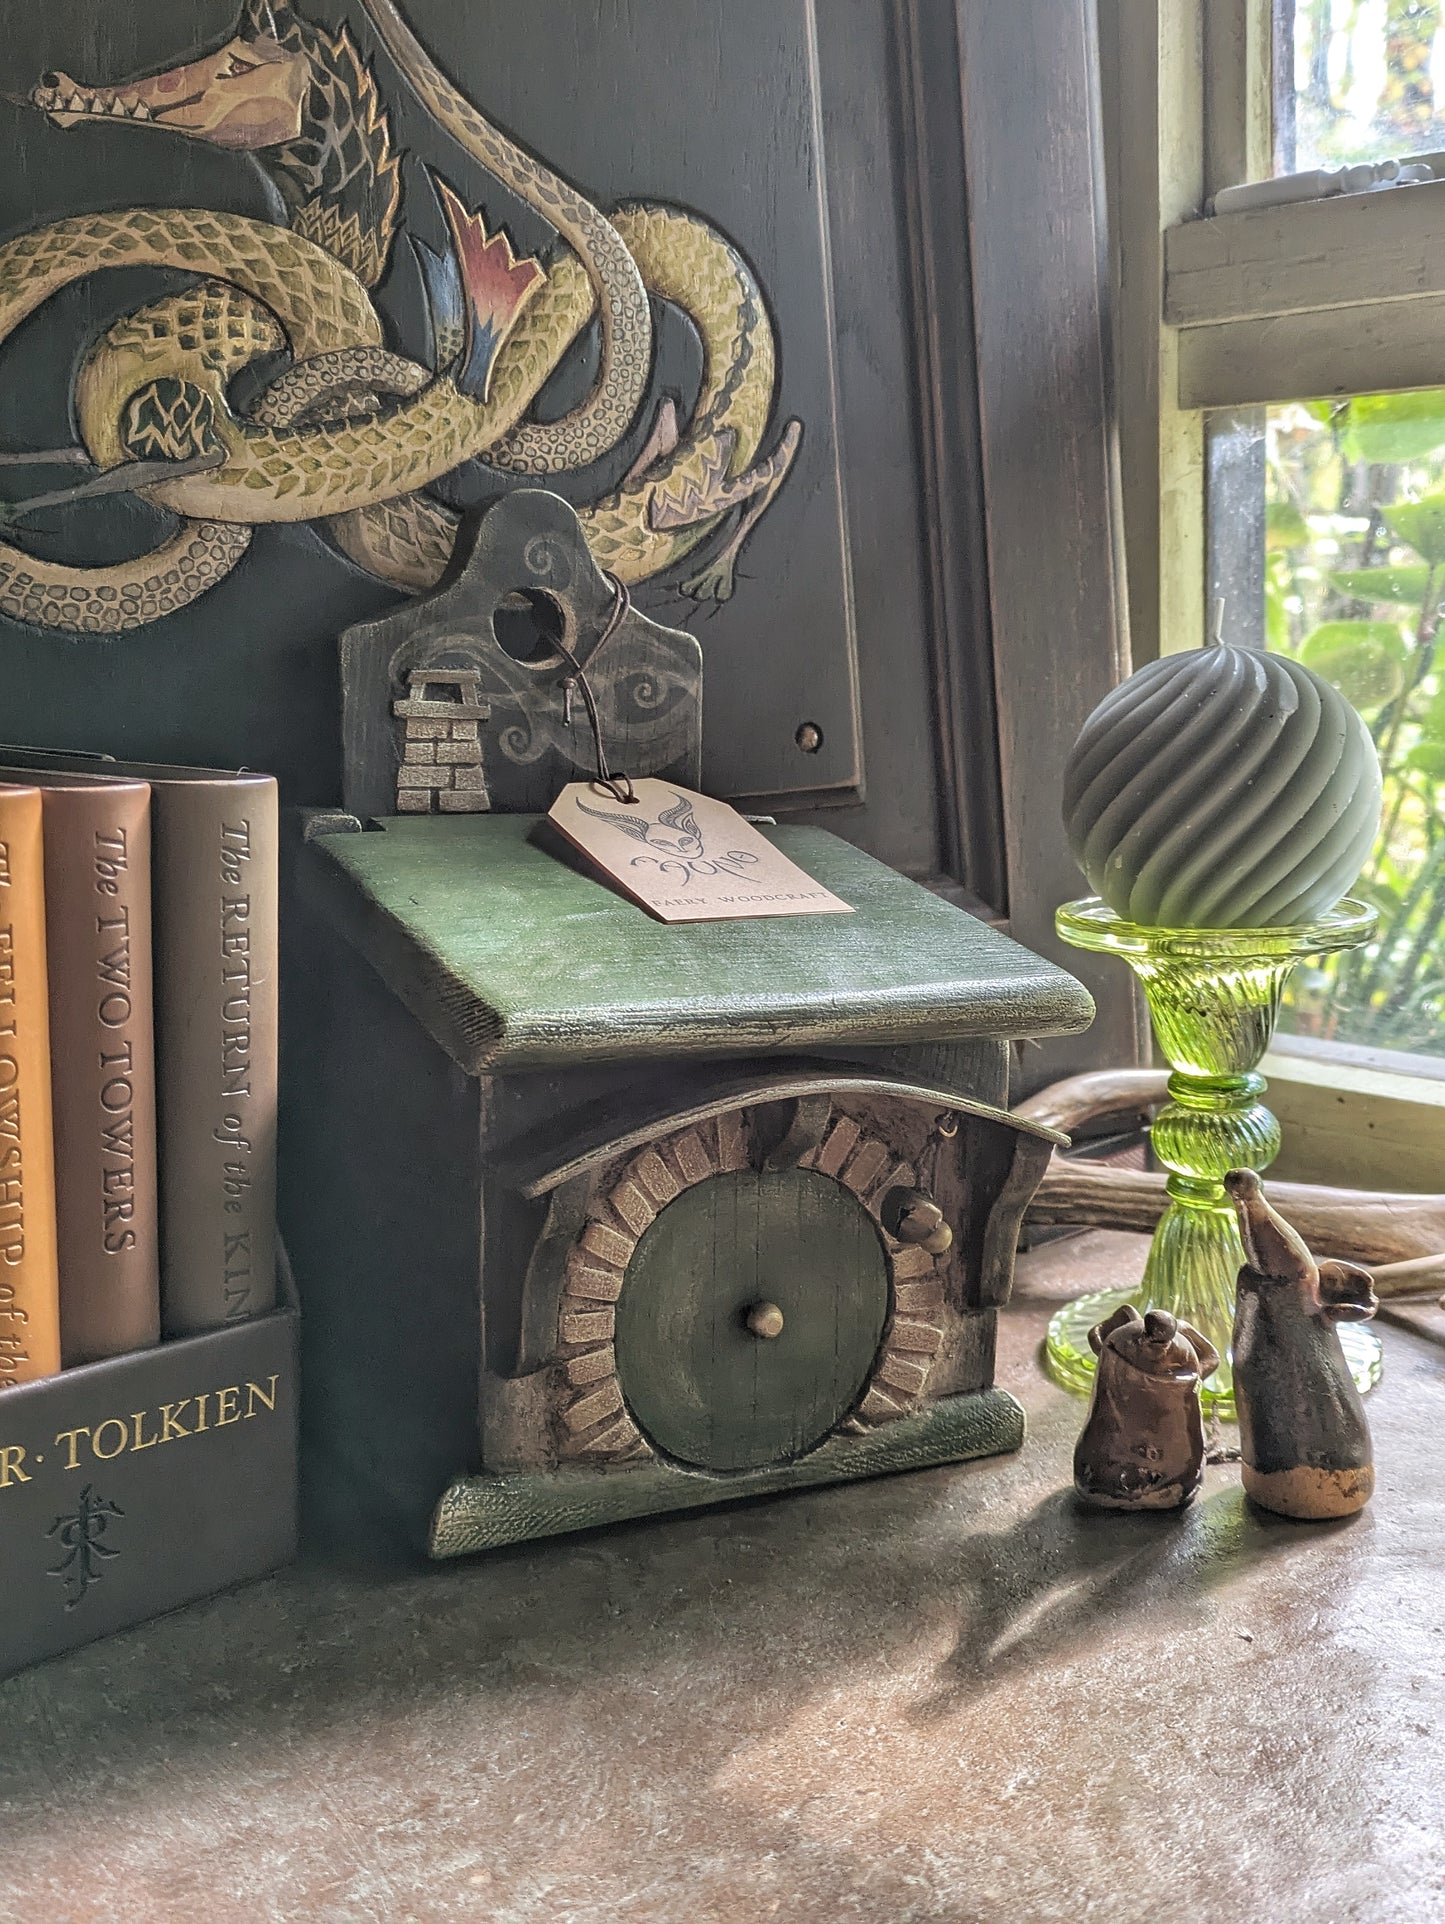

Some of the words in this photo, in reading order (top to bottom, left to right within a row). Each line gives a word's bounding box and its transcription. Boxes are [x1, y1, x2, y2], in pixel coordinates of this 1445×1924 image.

[93, 826, 129, 897] The
[219, 818, 251, 885] The
[651, 897, 707, 907] FAERY
[717, 891, 828, 904] WOODCRAFT
[96, 905, 132, 1029] TWO
[220, 894, 251, 1097] RETURN
[99, 1040, 136, 1256] TOWERS
[213, 1113, 252, 1154] of
[222, 1160, 252, 1214] the
[54, 1374, 279, 1470] TOLKIEN
